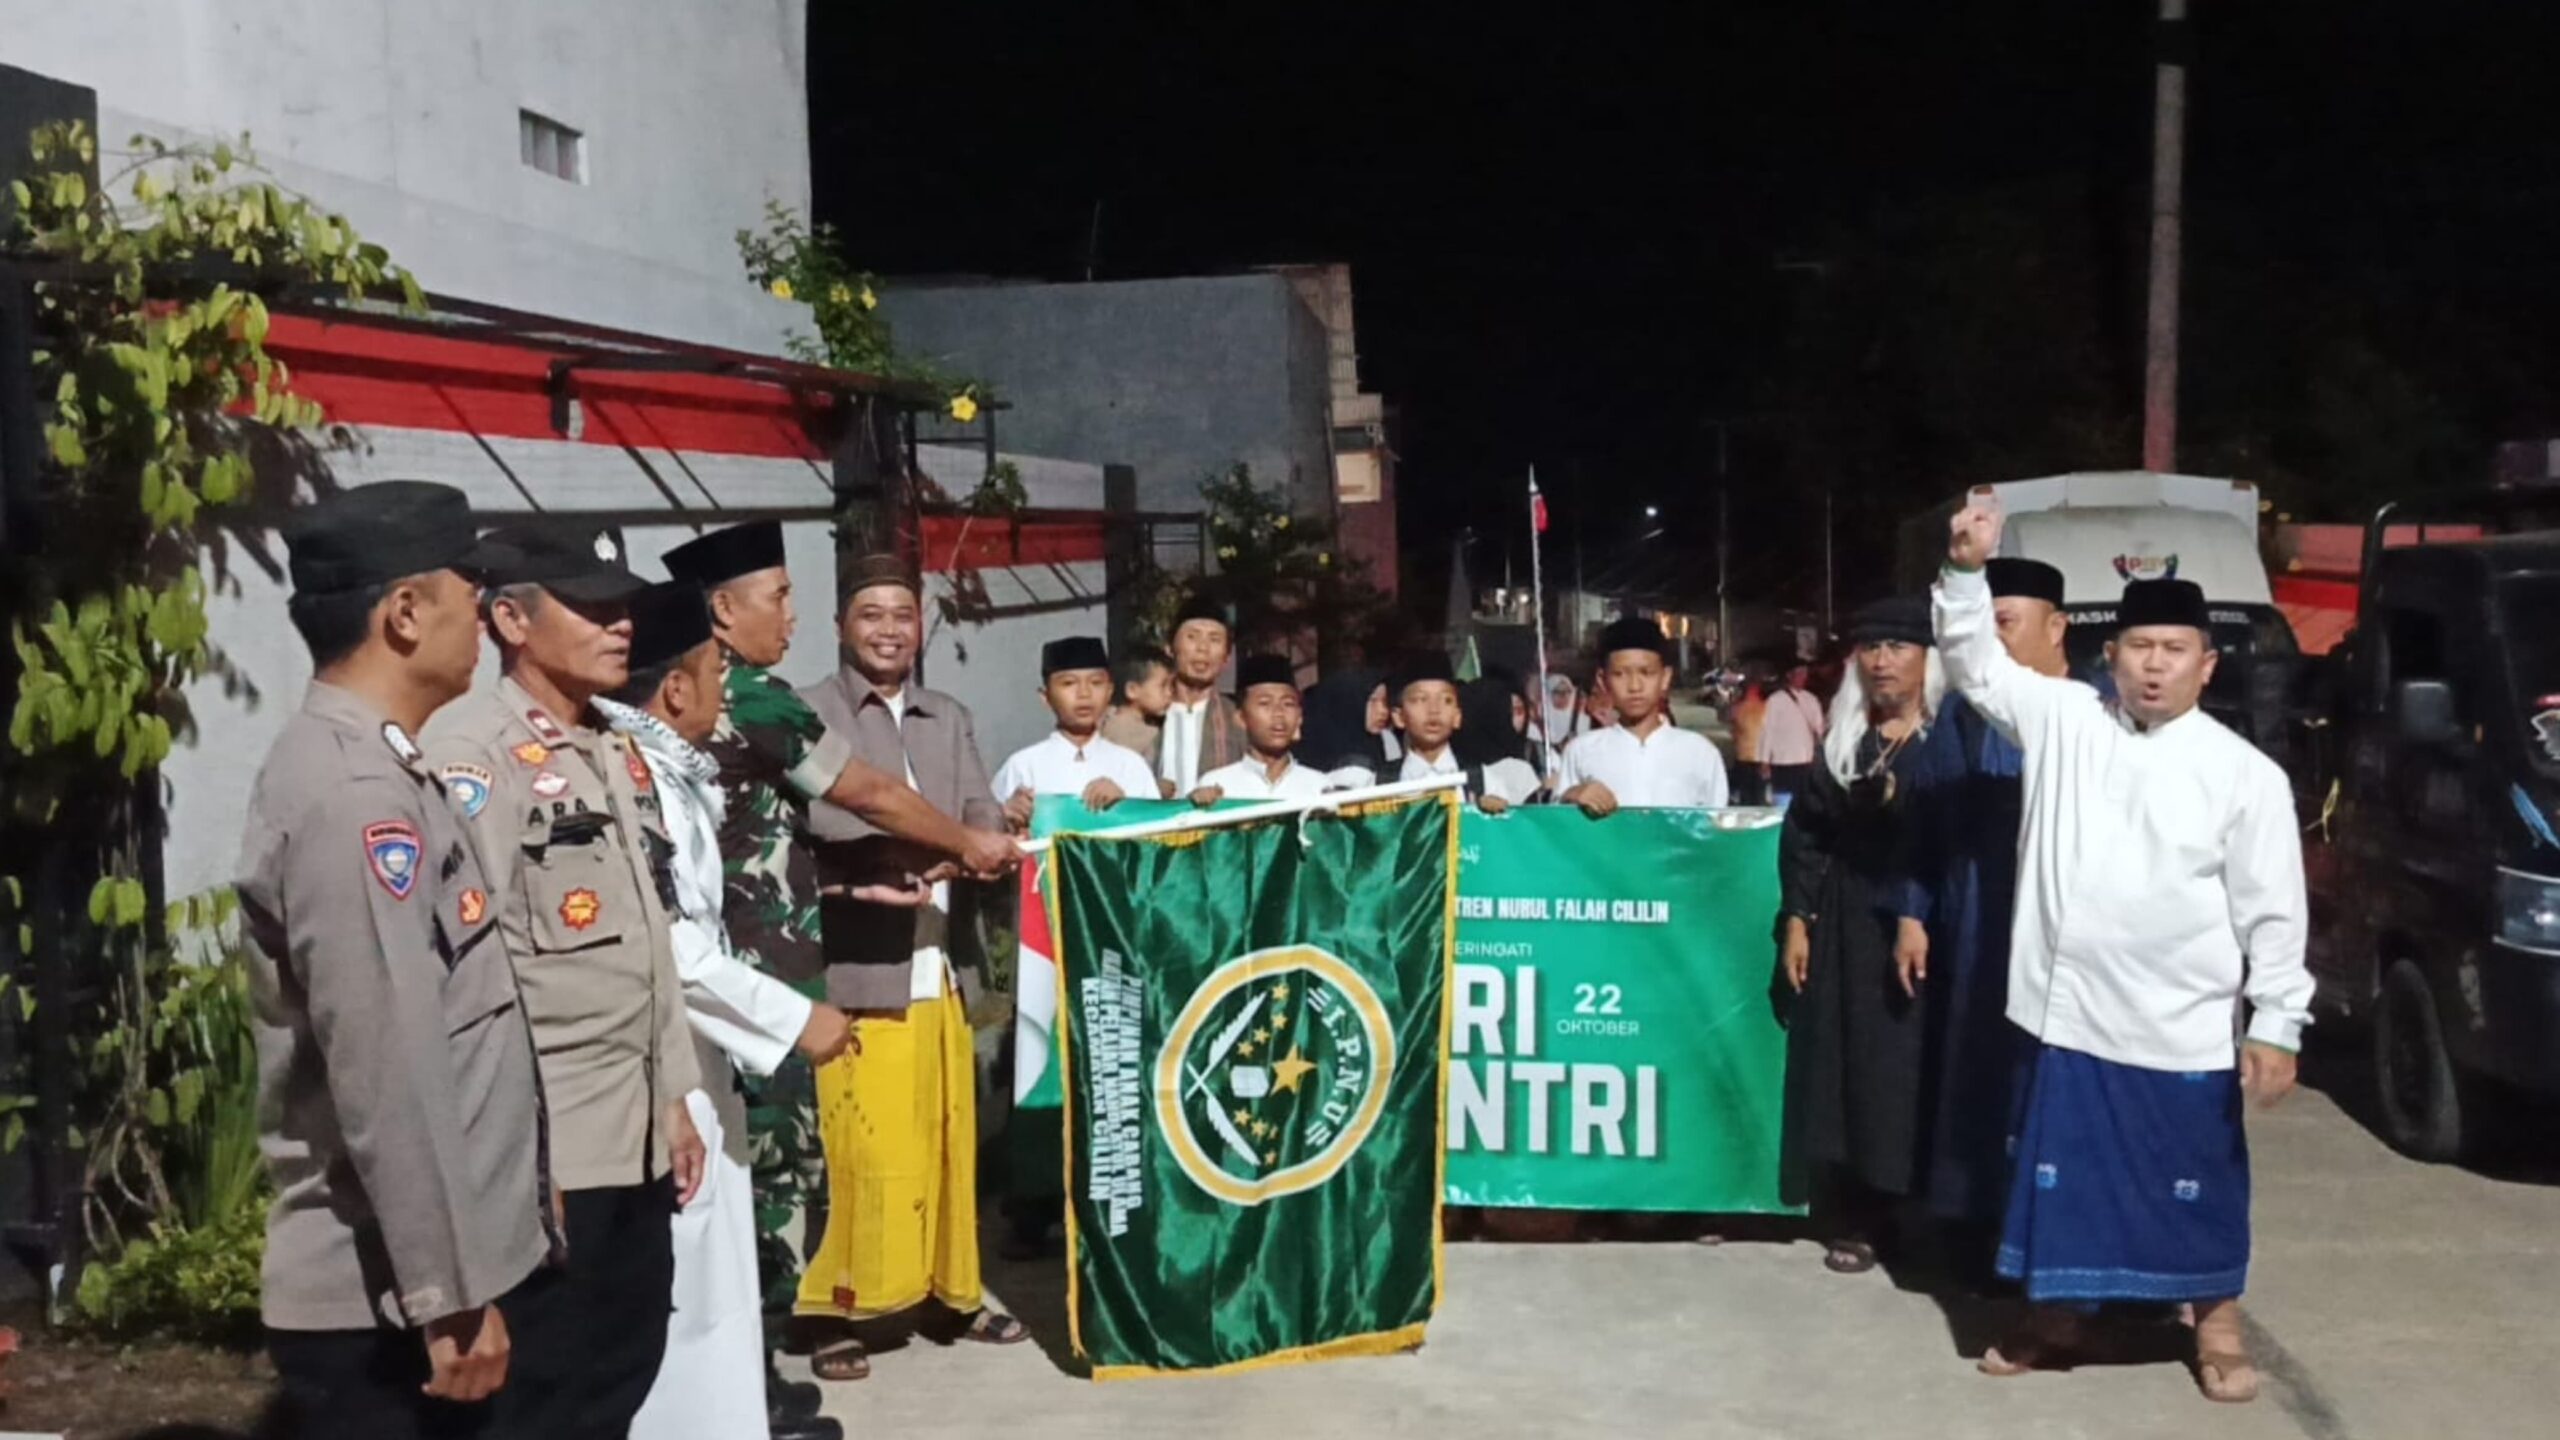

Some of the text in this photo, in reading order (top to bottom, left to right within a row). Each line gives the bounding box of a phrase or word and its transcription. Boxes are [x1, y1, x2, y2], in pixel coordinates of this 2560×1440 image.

[1555, 898, 1607, 922] FALAH
[1611, 900, 1670, 923] CILILIN
[1573, 983, 1623, 1015] 22
[1556, 1019, 1641, 1036] OKTOBER
